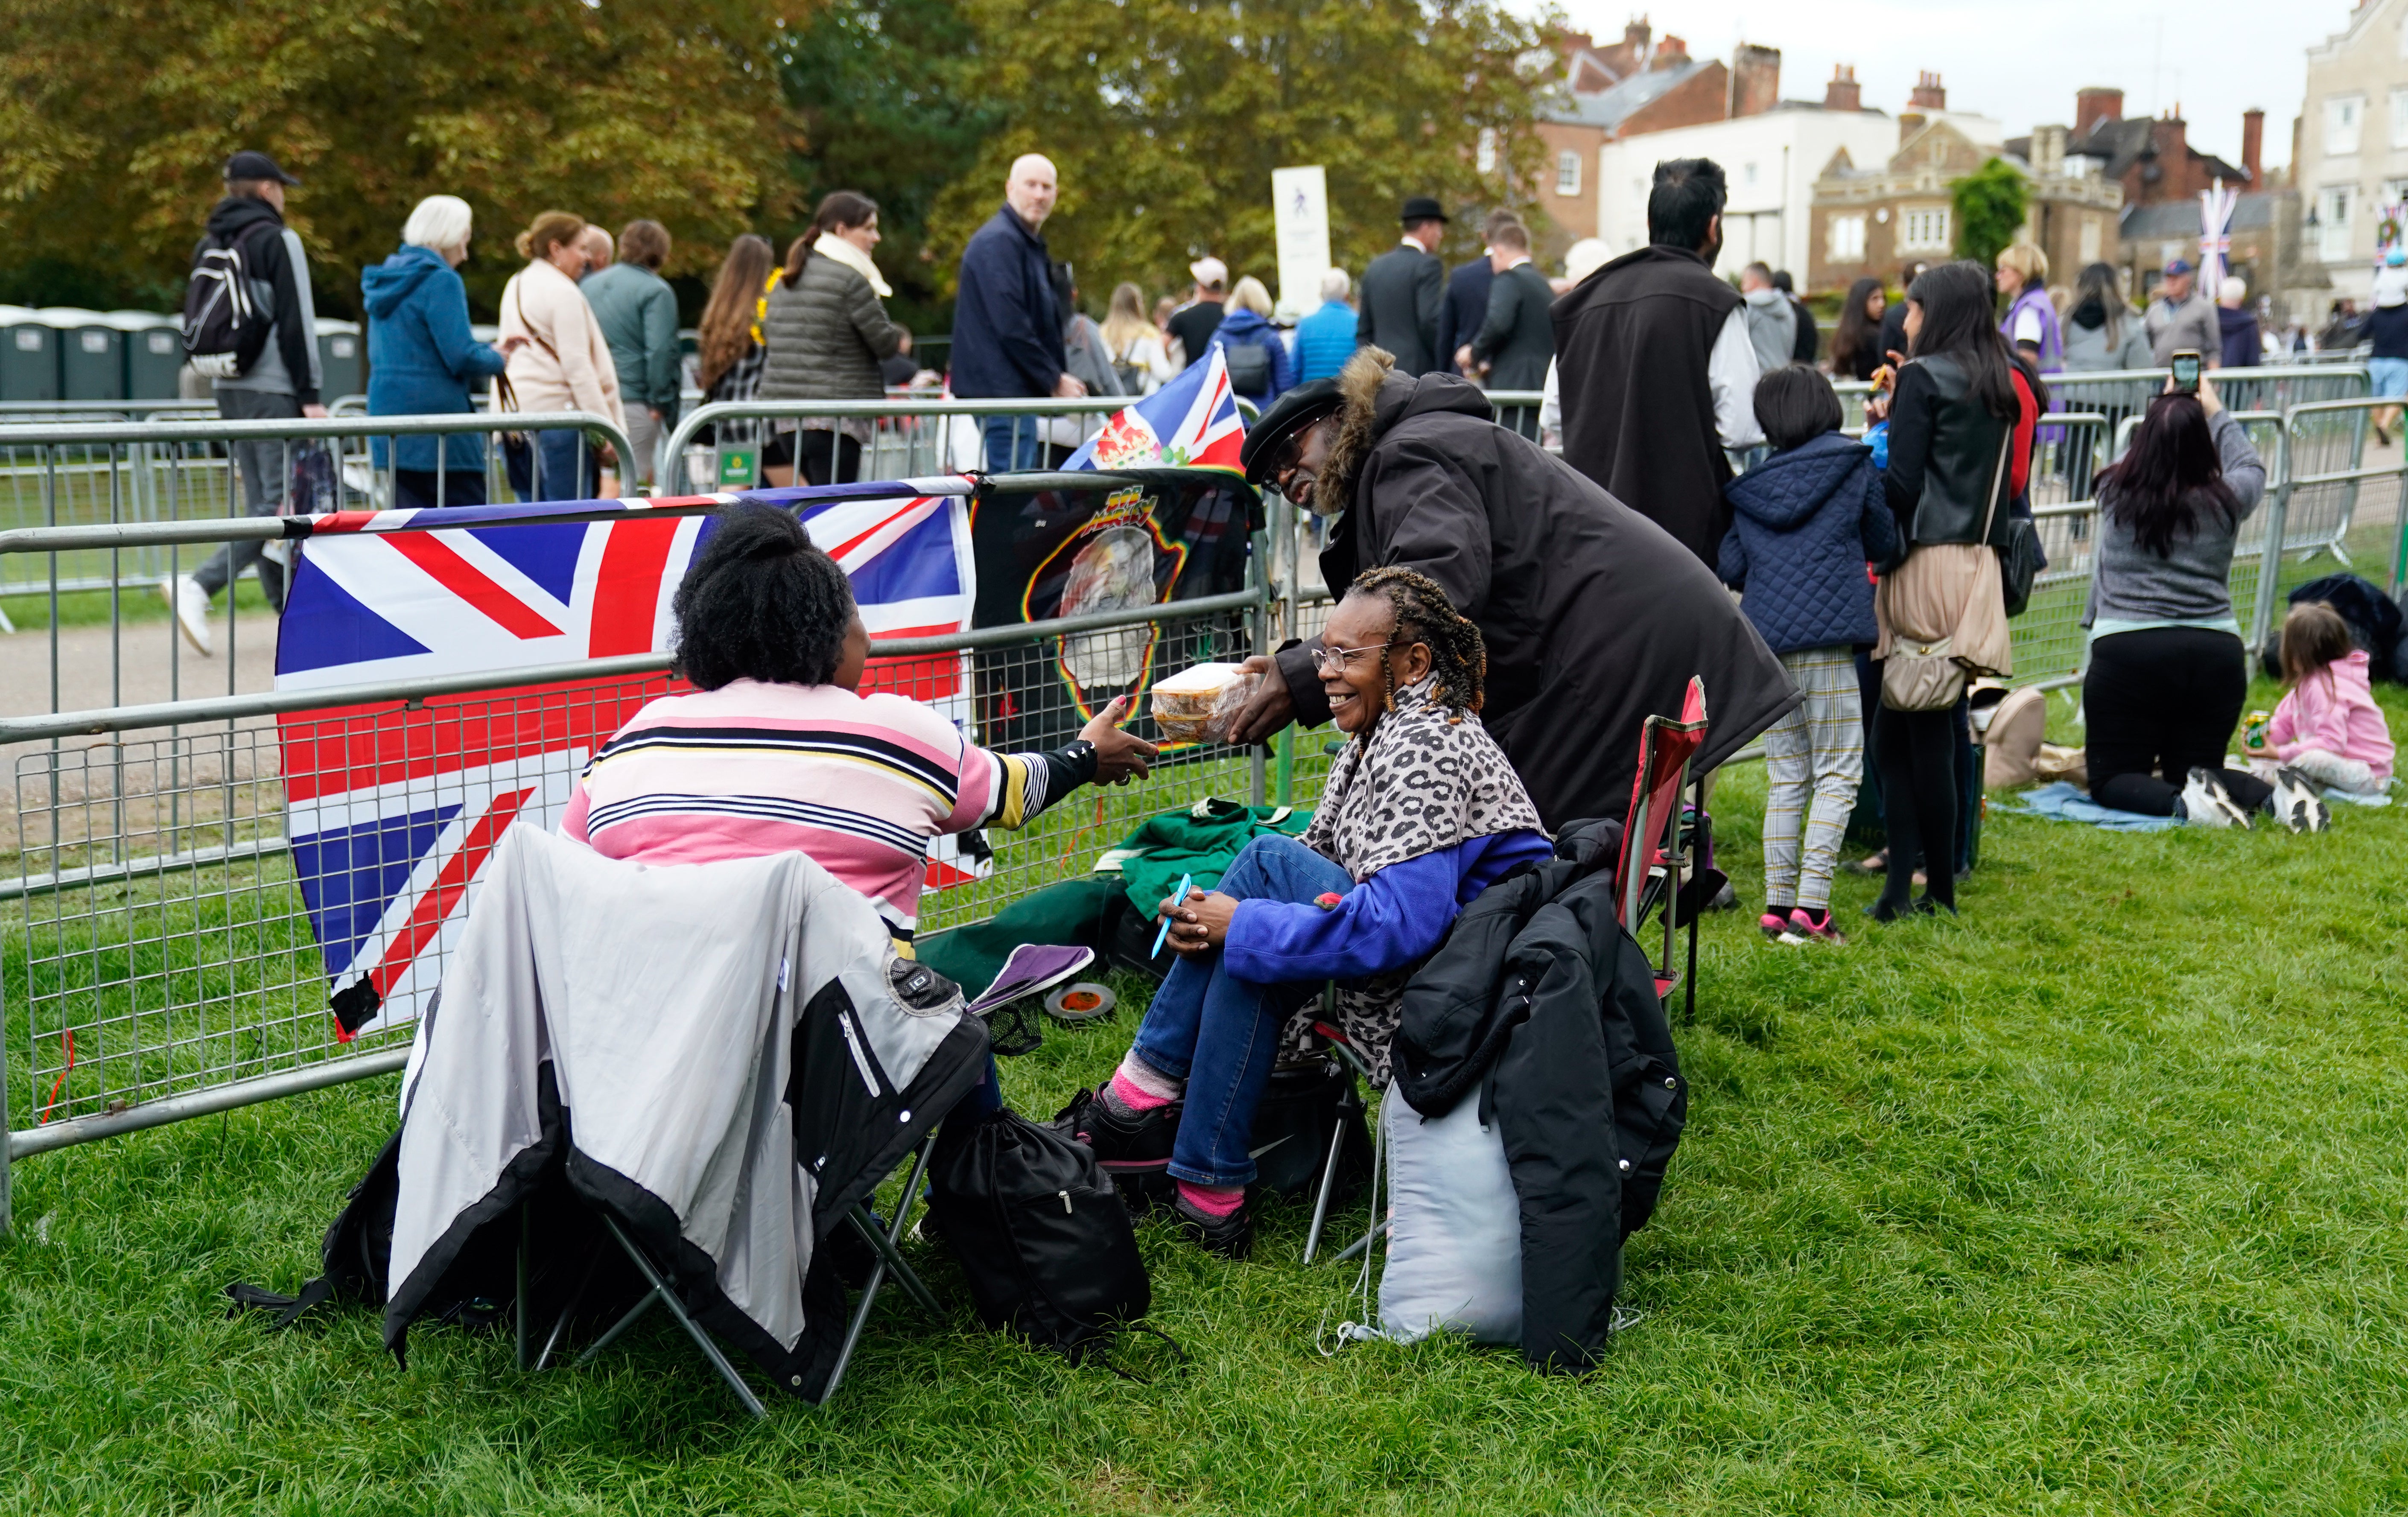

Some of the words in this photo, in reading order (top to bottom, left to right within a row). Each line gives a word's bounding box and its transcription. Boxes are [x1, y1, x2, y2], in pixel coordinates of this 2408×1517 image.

[1106, 484, 1144, 513] BOB
[1080, 494, 1159, 538] MARLEY
[1859, 826, 1888, 840] HO
